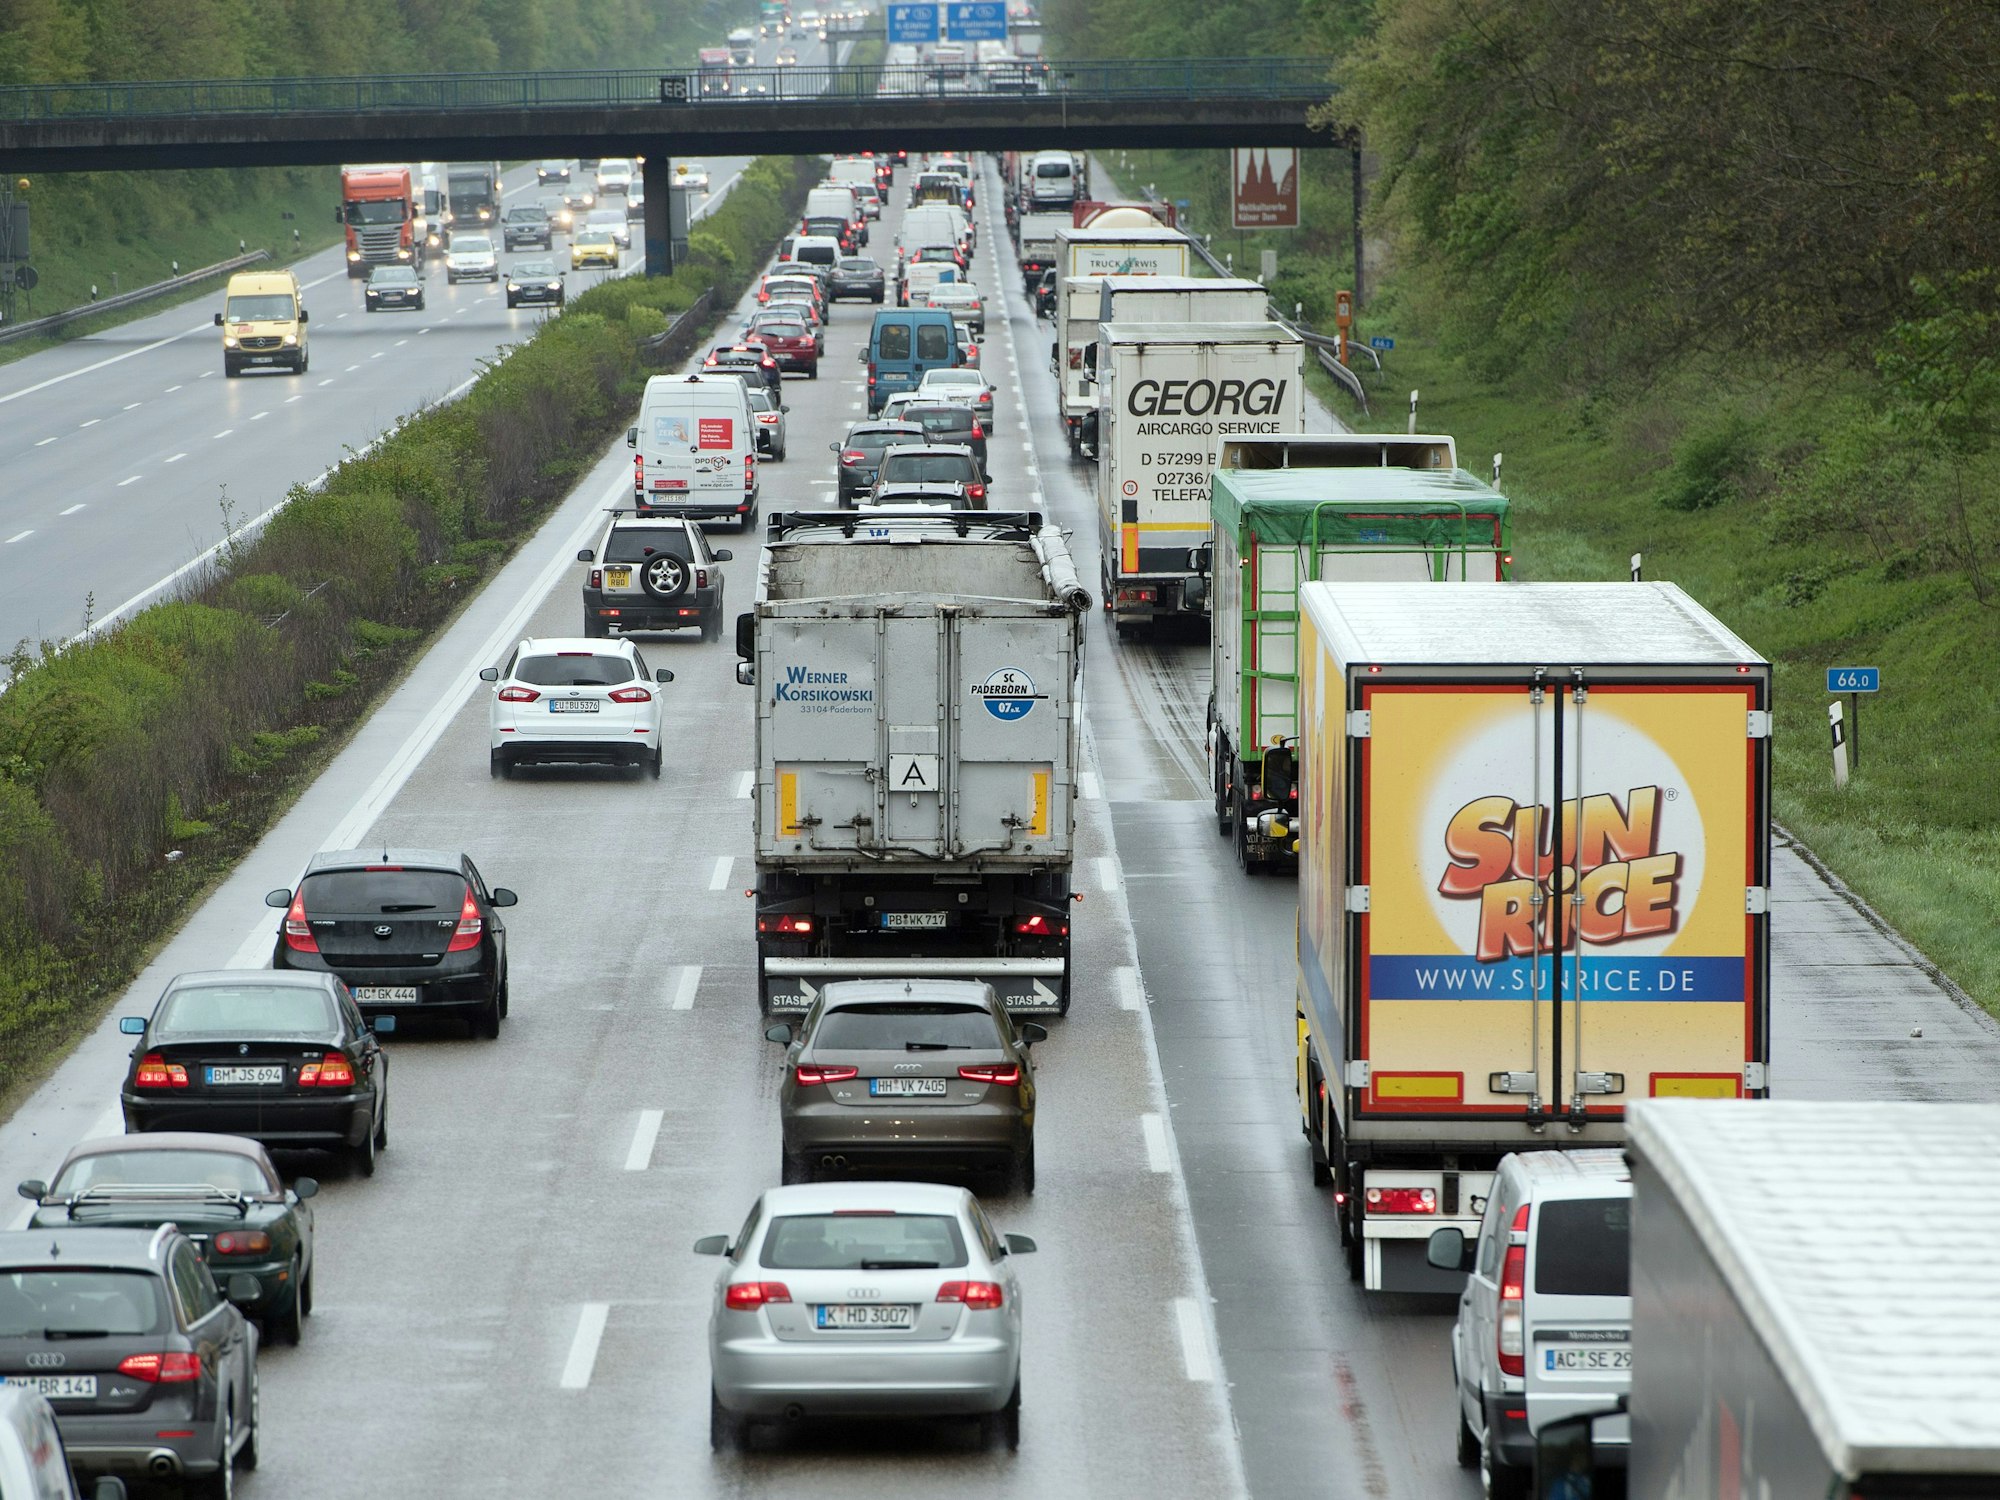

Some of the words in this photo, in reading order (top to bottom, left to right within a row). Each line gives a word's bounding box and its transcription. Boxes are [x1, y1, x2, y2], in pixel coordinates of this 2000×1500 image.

[1090, 260, 1120, 268] TRUCK
[1127, 378, 1288, 417] GEORGI
[1136, 422, 1214, 435] AIRCARGO
[1218, 422, 1281, 434] SERVICE
[1141, 453, 1152, 466] D
[1157, 453, 1203, 466] 57299
[786, 666, 848, 684] WERNER
[1004, 674, 1014, 682] SC
[1837, 672, 1869, 688] 66,0
[776, 683, 873, 701] KORSIKOWSKI
[971, 685, 1028, 694] PADERBORN
[580, 701, 598, 709] 5376
[830, 705, 872, 713] Paderborn
[998, 702, 1012, 713] 07
[901, 761, 926, 785] A
[1438, 784, 1659, 896] SUN
[888, 914, 903, 925] PB
[909, 914, 923, 925] WK
[925, 914, 945, 925] 717
[1415, 968, 1695, 992] WWW.SUNRICE.DE
[357, 989, 371, 1000] AC
[378, 989, 392, 1000] GK
[395, 989, 414, 1000] 444
[773, 995, 800, 1006] STAS
[1006, 995, 1033, 1006] STAS
[214, 1069, 231, 1081] BM
[239, 1069, 255, 1081] JS
[257, 1069, 280, 1081] 694
[878, 1080, 893, 1092] HH
[901, 1080, 916, 1092] VK
[917, 1080, 945, 1092] 7405
[827, 1309, 837, 1322] K
[847, 1309, 867, 1322] HD
[871, 1308, 908, 1323] 3007
[1556, 1352, 1577, 1368] AC
[1587, 1352, 1609, 1368] SE
[64, 1379, 92, 1394] 141
